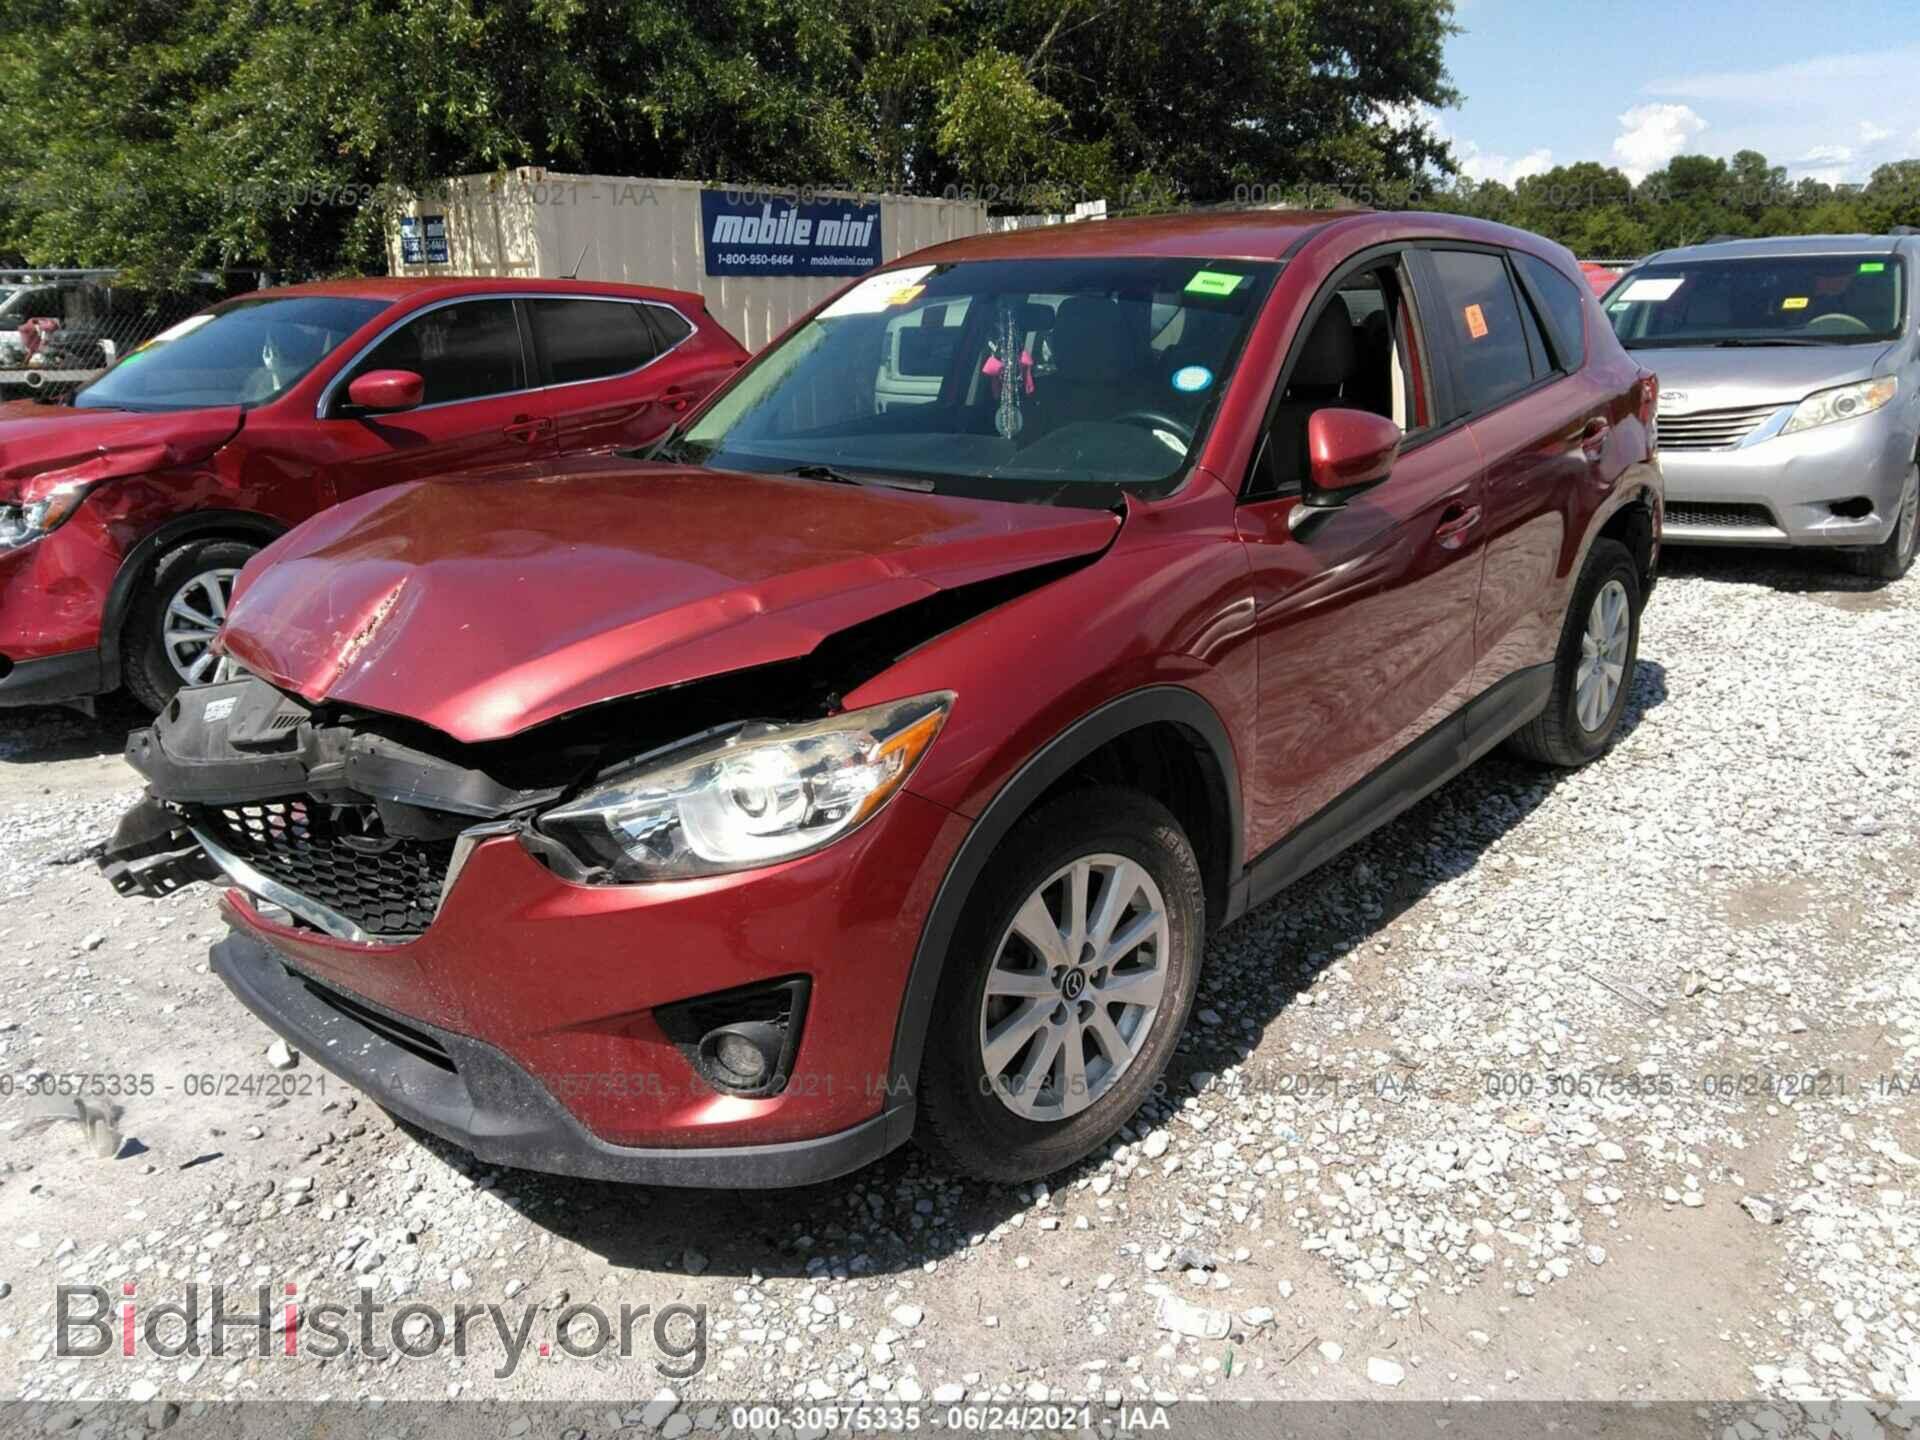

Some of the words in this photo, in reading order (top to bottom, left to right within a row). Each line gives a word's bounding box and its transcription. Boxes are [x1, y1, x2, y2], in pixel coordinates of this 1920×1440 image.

[712, 203, 812, 245] mobile
[815, 213, 873, 247] mini
[718, 254, 794, 265] 1-800-950-6464
[810, 255, 874, 266] mobilemini.com
